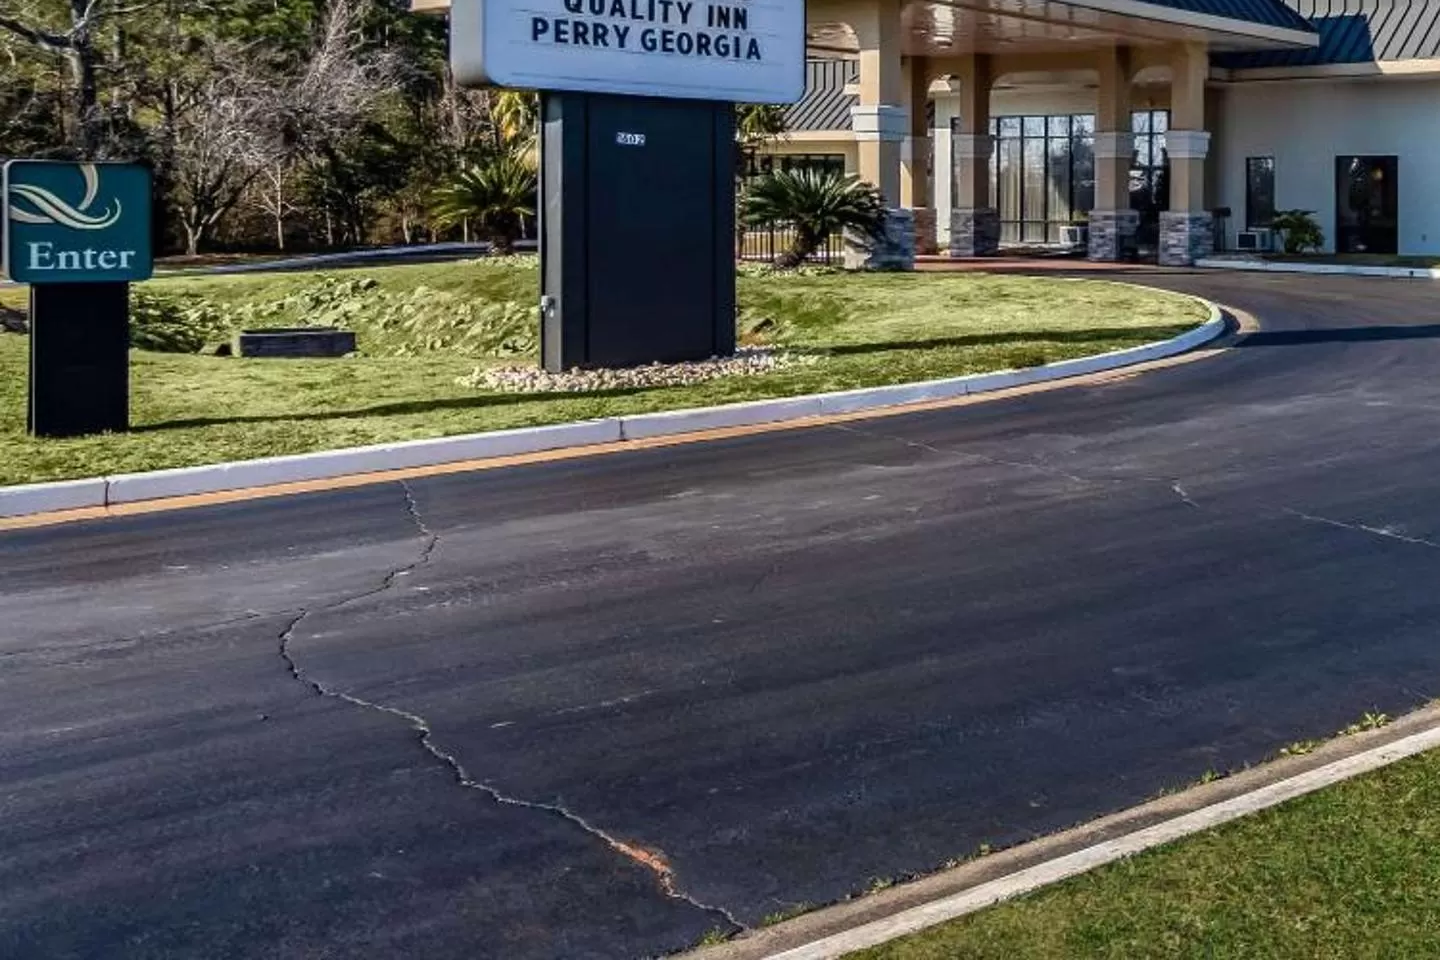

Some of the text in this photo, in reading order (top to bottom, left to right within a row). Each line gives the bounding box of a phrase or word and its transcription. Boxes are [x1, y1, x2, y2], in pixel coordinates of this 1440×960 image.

[708, 4, 748, 31] INN
[532, 17, 762, 60] PERRY GEORGIA
[27, 241, 137, 270] Enter
